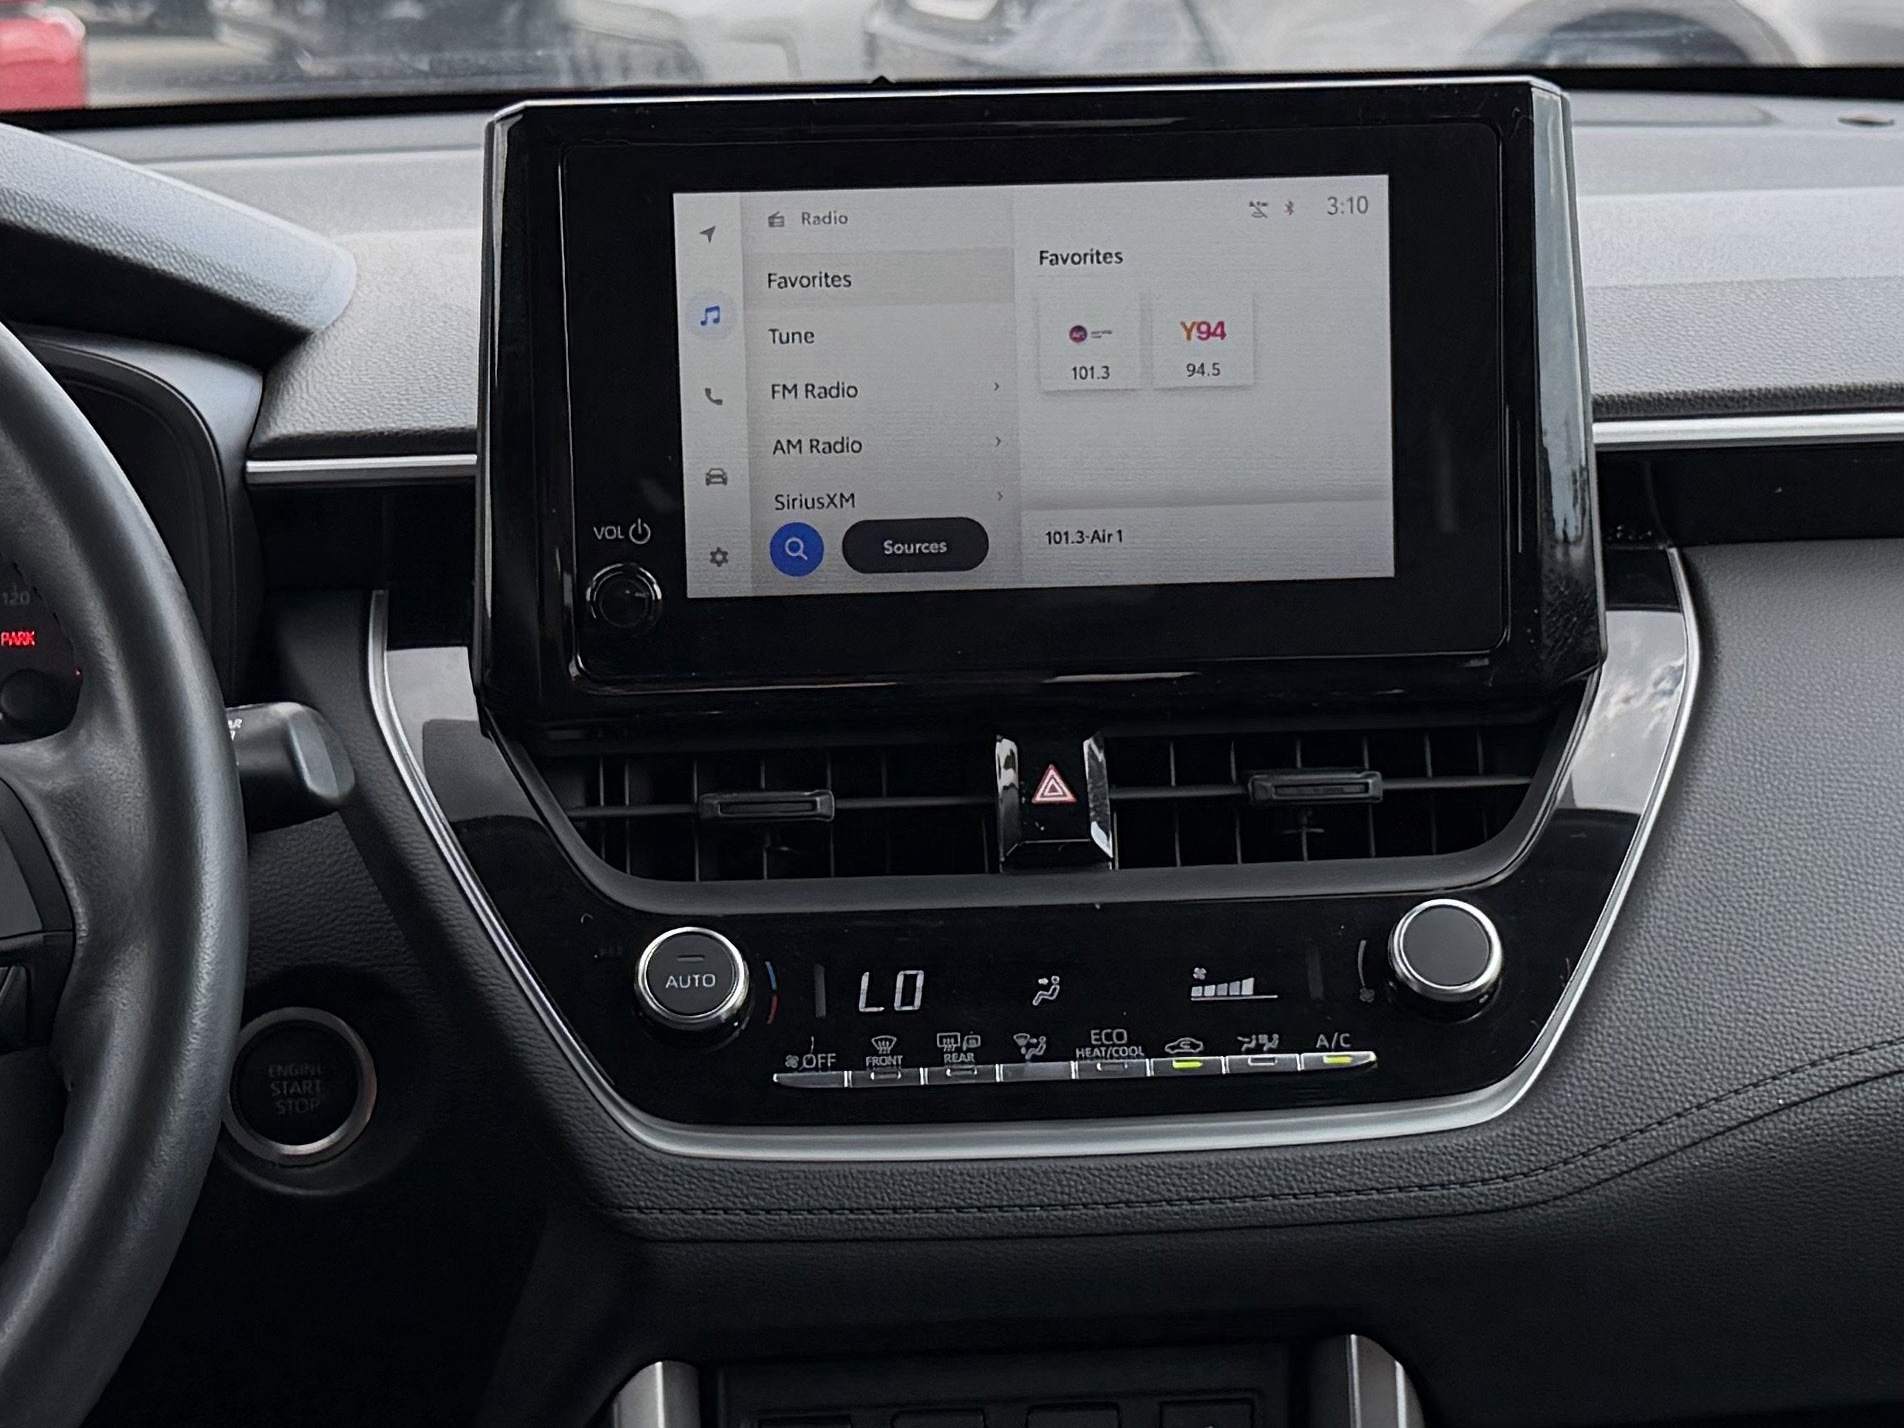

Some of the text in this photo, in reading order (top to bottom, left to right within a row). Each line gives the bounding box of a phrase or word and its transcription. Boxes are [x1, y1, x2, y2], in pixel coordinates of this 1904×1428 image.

[1327, 196, 1369, 216] 3:10
[801, 210, 848, 225] Radio
[1039, 248, 1123, 266] Favorites
[767, 271, 852, 289] Favorites
[768, 328, 815, 345] Tune
[1180, 320, 1227, 341] Y94
[1072, 365, 1110, 380] 101.3
[1186, 362, 1221, 377] 94.5
[771, 381, 858, 400] FM Radio
[772, 436, 863, 455] AM Radio
[774, 492, 856, 510] SiriusXM
[593, 525, 625, 540] VOL
[883, 539, 947, 555] Sources
[2, 589, 31, 606] 120
[0, 630, 36, 648] PARK
[665, 973, 716, 989] AUTO
[859, 970, 924, 1012] LO
[1090, 1029, 1128, 1045] ECO
[1316, 1032, 1352, 1049] A/C
[865, 1055, 903, 1066] FRONT
[944, 1052, 975, 1064] REAR
[1076, 1045, 1145, 1059] HEAT/COOL
[802, 1053, 837, 1069] OFF
[270, 1079, 321, 1097] START
[275, 1098, 321, 1116] STOP
